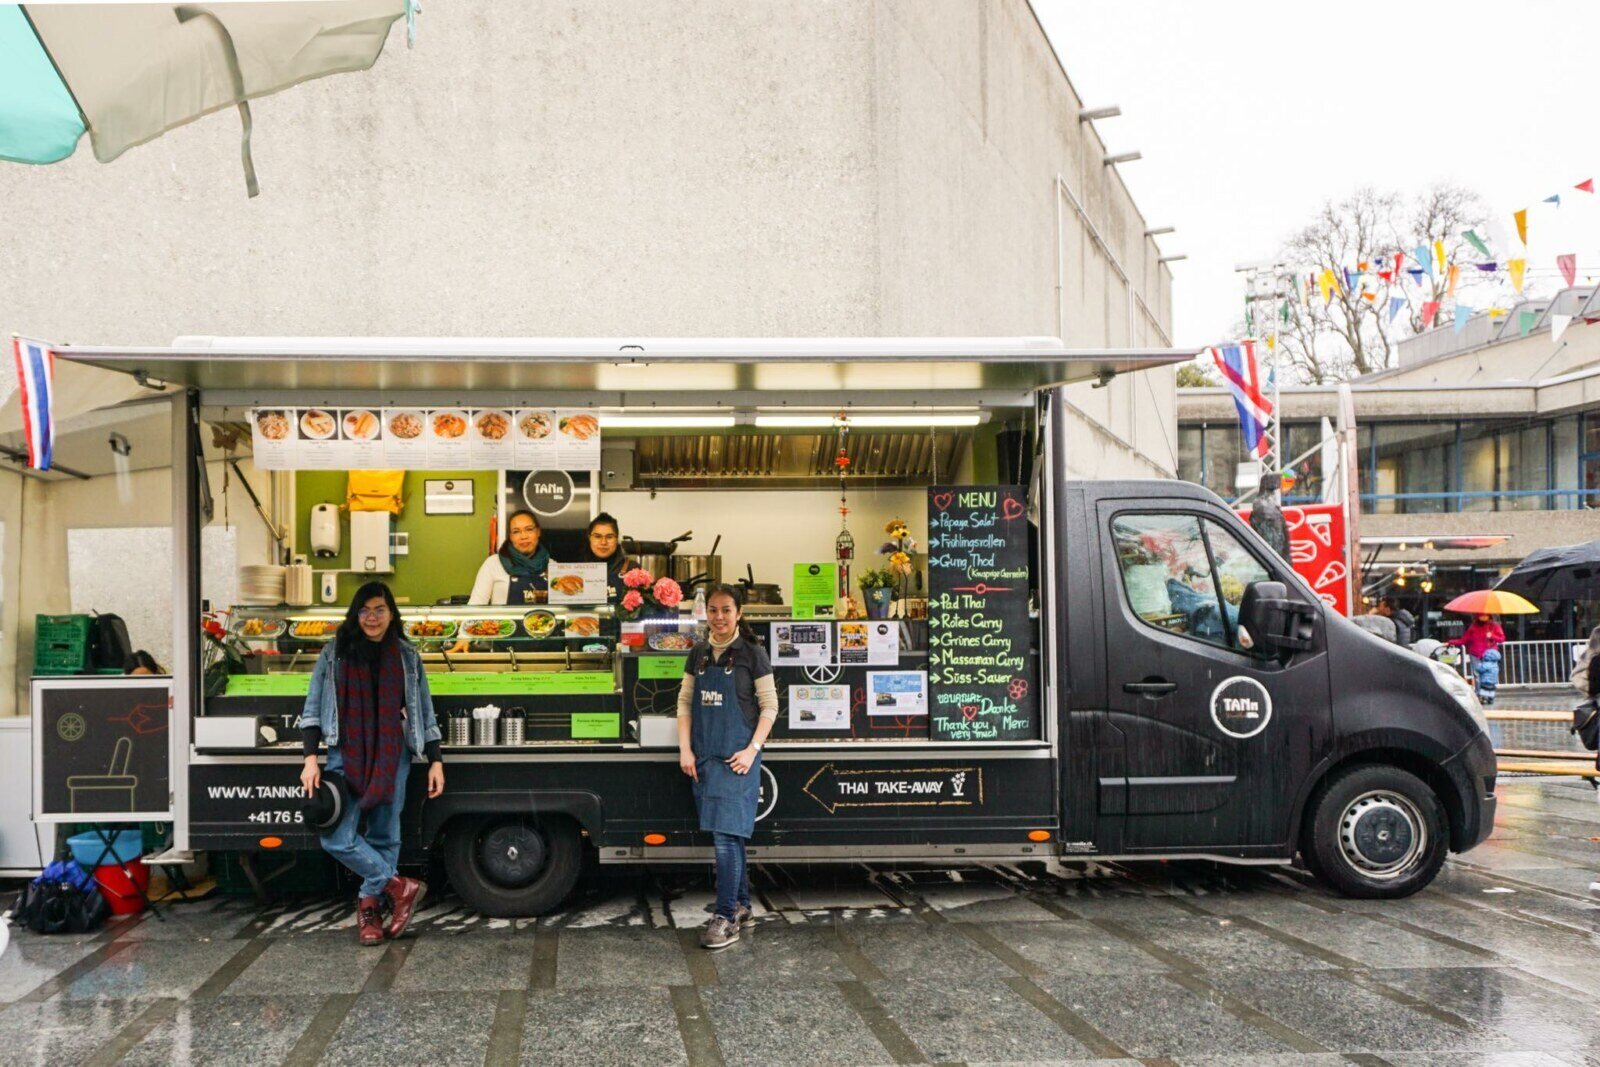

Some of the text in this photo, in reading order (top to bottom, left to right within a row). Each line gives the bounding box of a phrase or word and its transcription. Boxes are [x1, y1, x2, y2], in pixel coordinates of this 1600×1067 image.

[958, 491, 997, 508] MENU
[940, 511, 999, 532] Papaya Salat
[940, 553, 995, 571] Gung Thod
[940, 593, 986, 610] Pad Thai
[941, 612, 1003, 634] Rotes Curry
[981, 633, 1012, 653] Curry
[942, 648, 1025, 672] Massaman Curry
[978, 697, 1018, 715] Danke
[933, 716, 989, 733] Thank you
[1002, 715, 1030, 731] Merci
[950, 726, 998, 741] very much
[838, 780, 944, 795] THAI TAKE-AWAY
[248, 811, 271, 824] +41
[273, 811, 291, 824] 76
